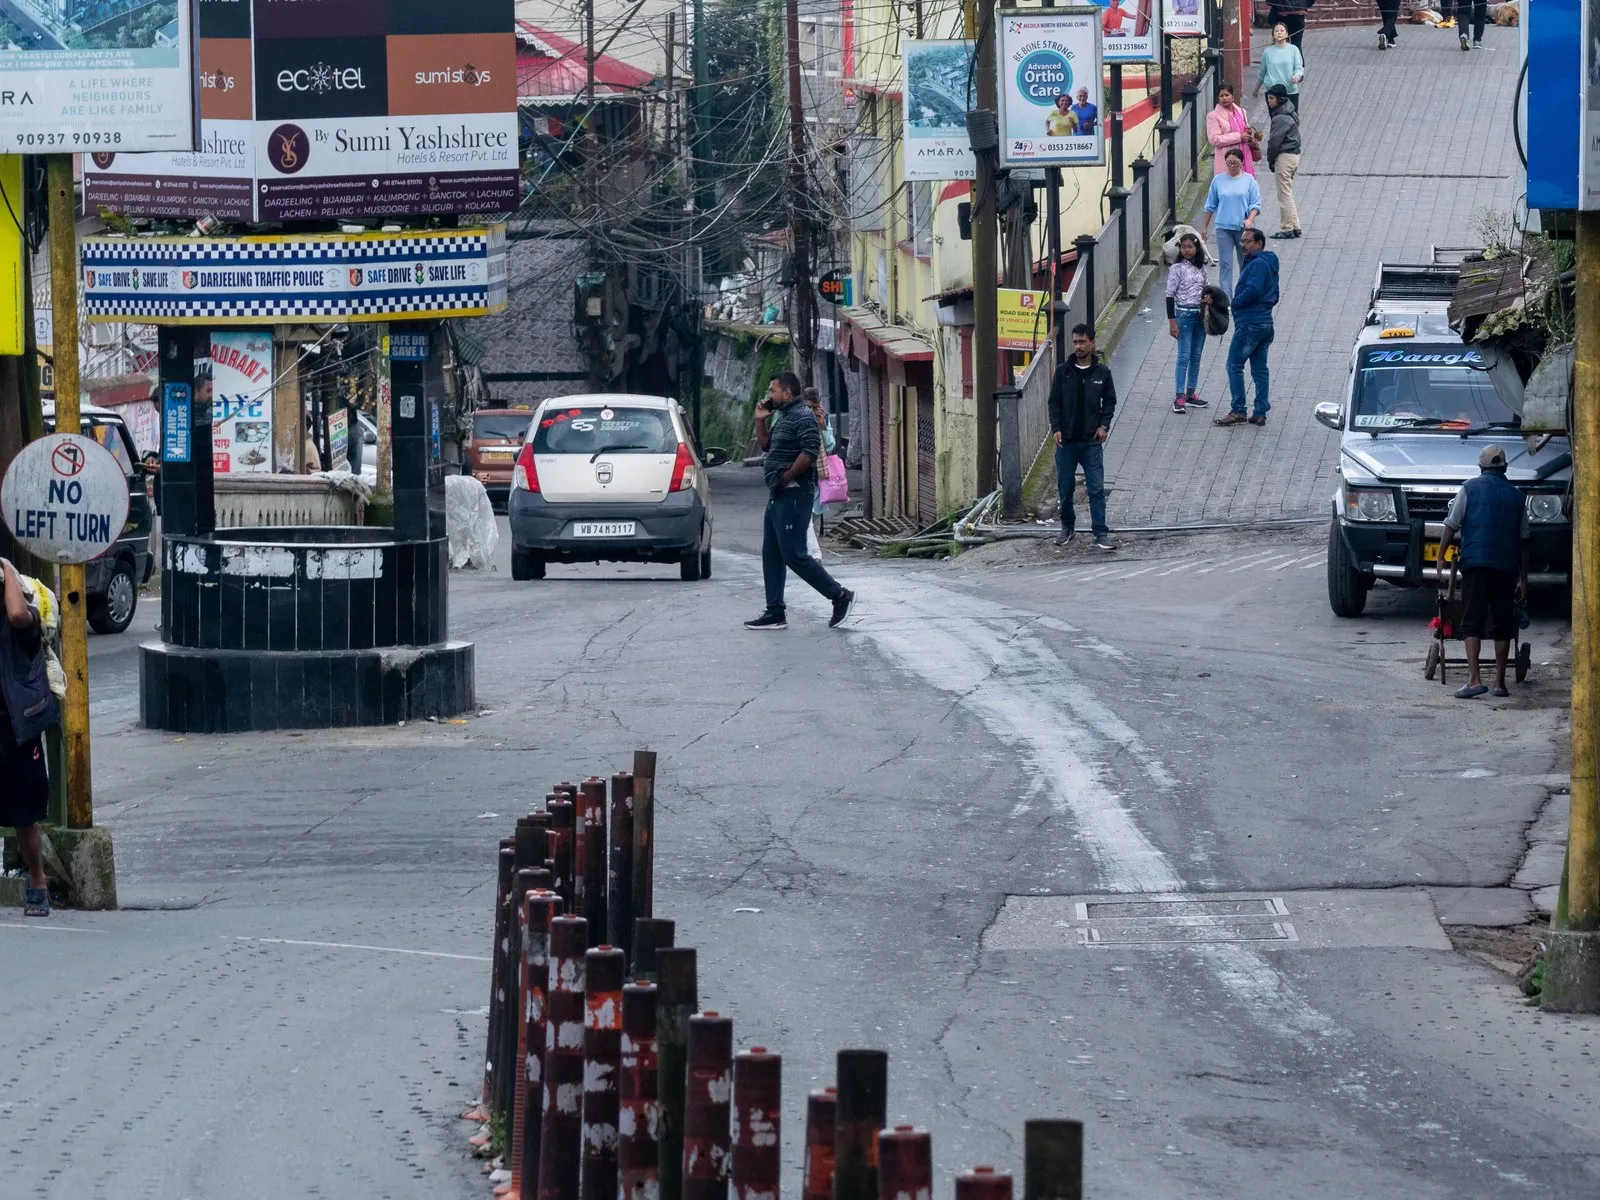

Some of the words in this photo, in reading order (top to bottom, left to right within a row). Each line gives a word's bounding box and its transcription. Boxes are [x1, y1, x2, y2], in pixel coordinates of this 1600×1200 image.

[1013, 51, 1023, 62] BE
[1022, 41, 1041, 55] BONE
[1042, 40, 1075, 61] STRONG!
[69, 80, 77, 88] A
[81, 79, 107, 88] LIFE
[111, 78, 154, 88] WHERE
[1025, 70, 1064, 82] Ortho
[73, 91, 152, 102] NEIGHBOURS
[1029, 84, 1061, 96] Care
[61, 106, 84, 116] ARE
[89, 105, 116, 115] LIKE
[120, 104, 163, 114] FAMILY
[16, 133, 65, 145] 90937
[72, 132, 122, 144] 90938
[315, 129, 329, 143] By
[335, 127, 392, 152] Sumi
[396, 124, 508, 150] Yashshree
[397, 152, 427, 163] Hotels
[429, 151, 436, 162] &
[439, 151, 468, 162] Resort
[918, 148, 964, 157] AMARA
[172, 156, 191, 167] Hotels
[193, 157, 198, 167] &
[199, 157, 219, 168] Resort
[88, 192, 119, 201] DARJEELING
[156, 195, 188, 204] KALIMPONG
[193, 197, 218, 205] GANGTOK
[224, 198, 249, 207] LACHUNG
[264, 197, 313, 207] DARJEELING
[322, 195, 364, 205] BIJANBARI
[373, 193, 420, 202] KALIMPONG
[429, 191, 467, 200] GANGTOK
[476, 189, 514, 198] LACHUNG
[124, 205, 144, 214] PELLING
[150, 207, 181, 215] MUSSOORIE
[216, 209, 240, 218] KOLKATA
[279, 209, 312, 218] LACHEN
[321, 207, 354, 216] PELLING
[363, 204, 410, 214] MUSSOORIE
[421, 203, 454, 212] SILIGURI
[465, 201, 500, 210] KOLKATA
[98, 274, 112, 287] SAFE
[112, 274, 130, 287] DRIVE
[142, 273, 157, 288] SAVE
[158, 273, 169, 287] LIFE
[200, 271, 253, 288] DARJEELING
[254, 270, 291, 287] TRAFFIC
[293, 270, 324, 287] POLICE
[367, 269, 387, 284] SAFE
[387, 267, 412, 284] DRIVE
[429, 266, 449, 282] SAVE
[450, 265, 466, 280] LIFE
[389, 335, 410, 346] SAFE
[392, 346, 417, 356] SAVE
[211, 344, 269, 383] AURANT
[167, 409, 177, 435] SAVE
[178, 405, 187, 429] SAFE
[333, 421, 343, 431] TO
[167, 437, 177, 459] LIFE
[177, 432, 187, 459] DRIVE
[48, 480, 82, 504] NO
[15, 509, 57, 539] LEFT
[66, 512, 111, 543] TURN
[580, 524, 633, 534] WB74M3117
